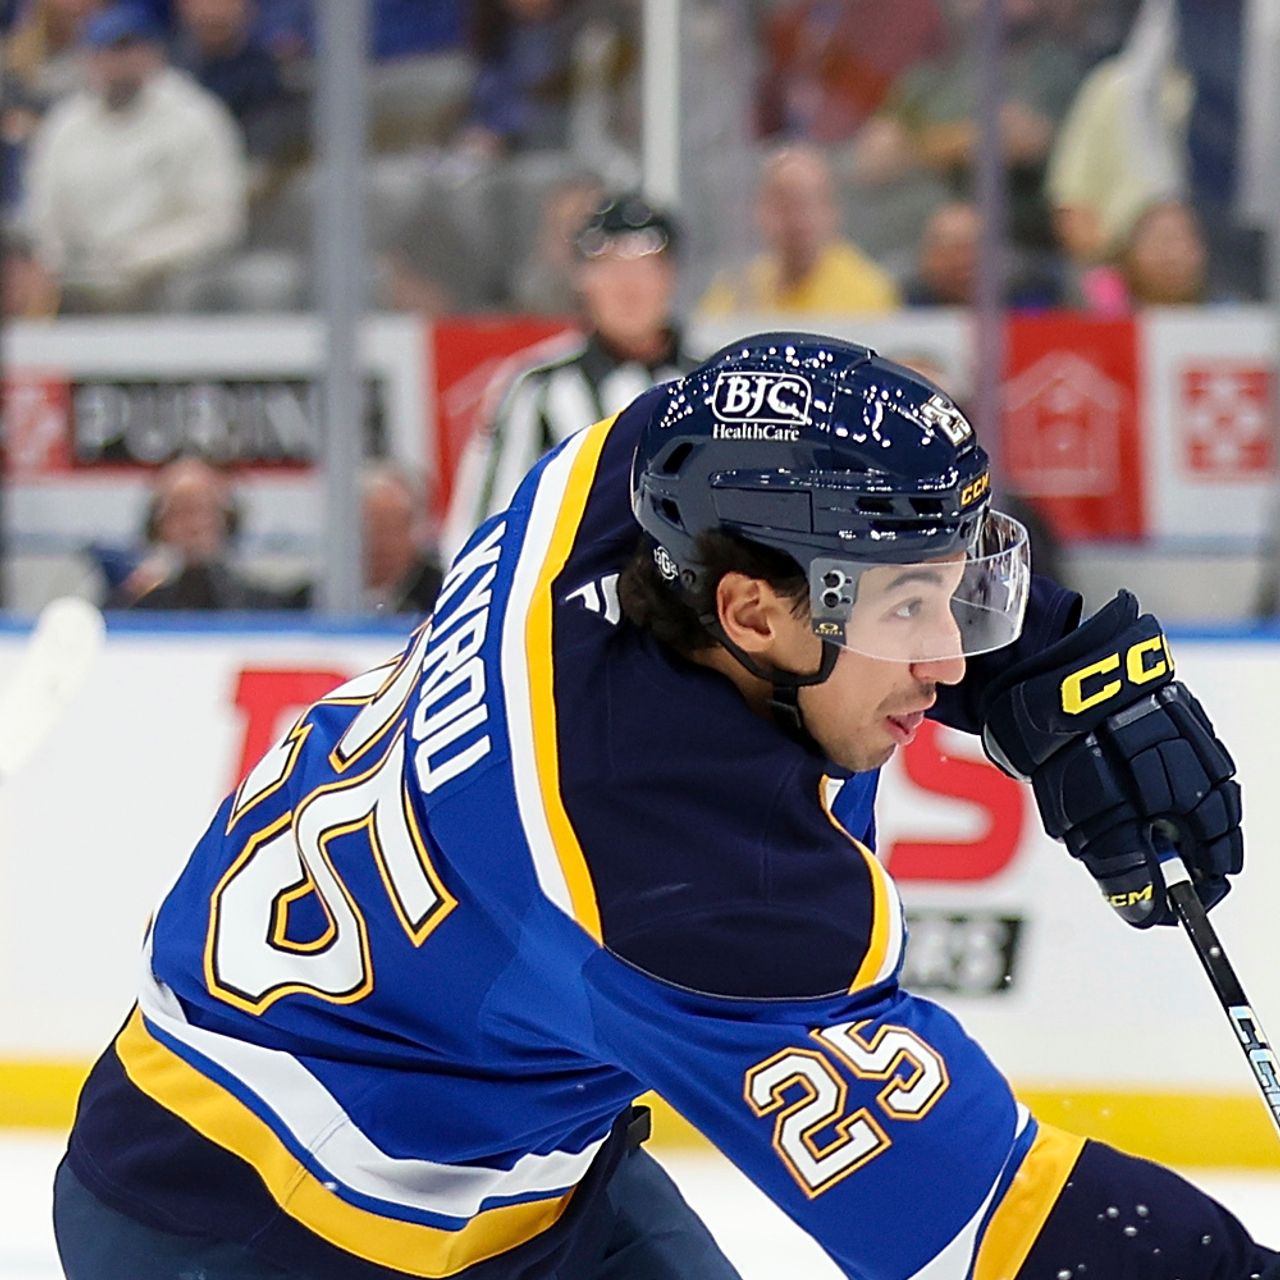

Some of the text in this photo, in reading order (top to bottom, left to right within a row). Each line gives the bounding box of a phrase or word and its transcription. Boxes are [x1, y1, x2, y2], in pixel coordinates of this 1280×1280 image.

[74, 382, 326, 460] PURIN
[713, 423, 800, 441] HealthCare
[722, 376, 801, 417] BJC
[412, 520, 507, 794] KYROU
[1061, 632, 1175, 715] CC
[1105, 883, 1153, 907] CM
[744, 1019, 950, 1200] 25
